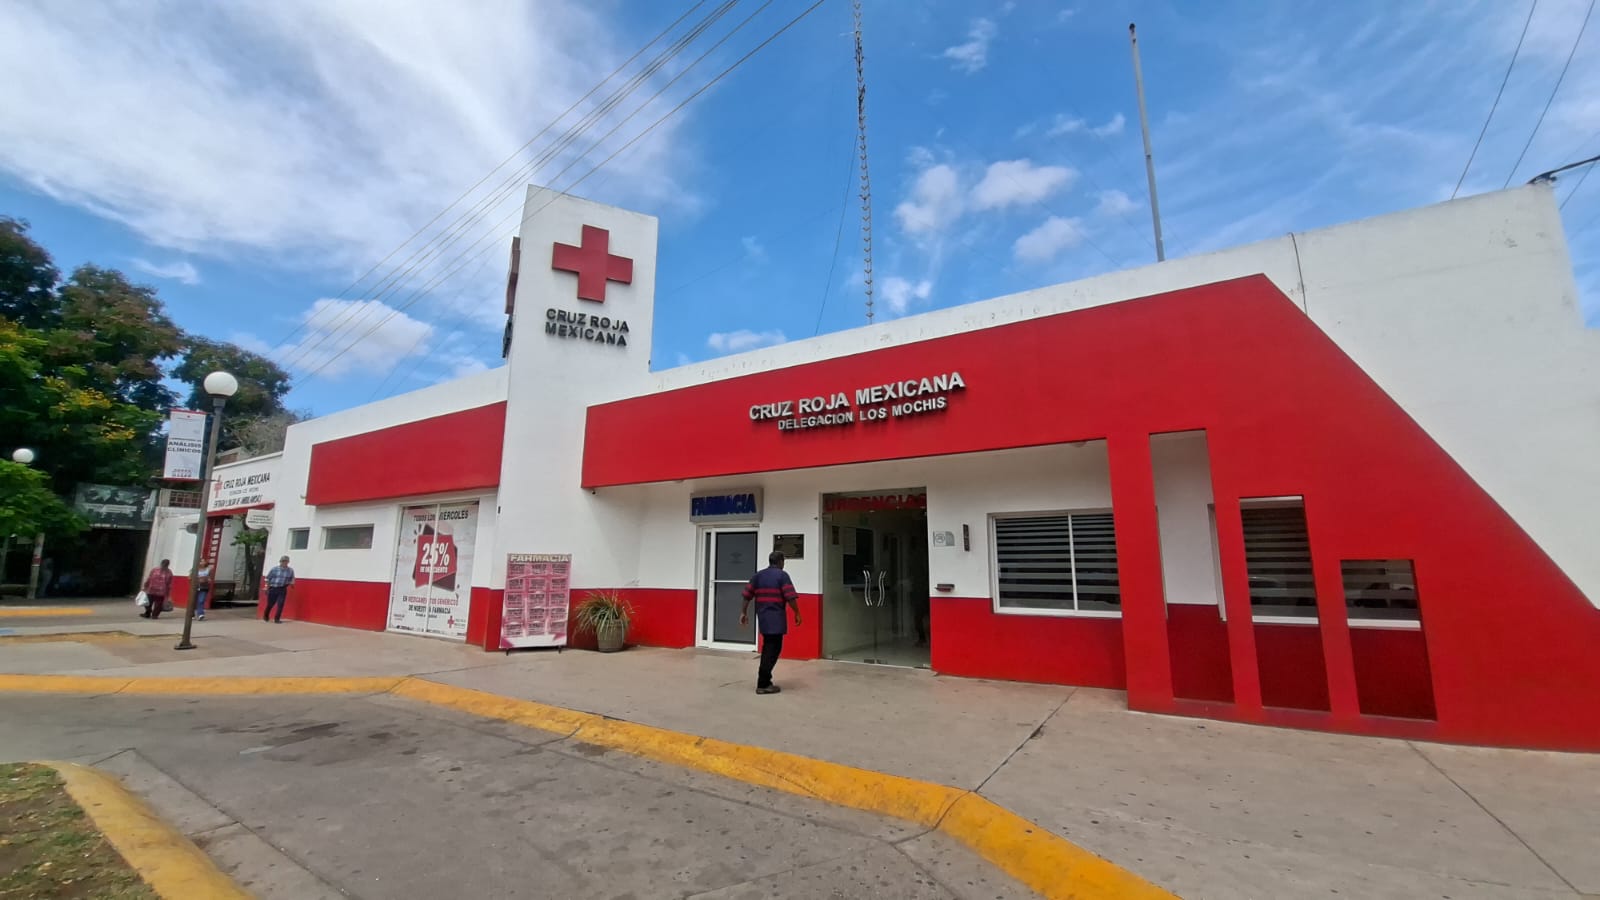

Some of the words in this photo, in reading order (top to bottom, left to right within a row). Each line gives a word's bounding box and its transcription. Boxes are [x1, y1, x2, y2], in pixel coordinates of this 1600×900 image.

[546, 308, 587, 325] CRUZ
[590, 315, 629, 333] ROJA
[545, 322, 627, 346] MEXICANA
[749, 401, 793, 420] CRUZ
[799, 392, 849, 414] ROJA
[855, 371, 965, 406] MEXICANA
[778, 411, 853, 430] DELEGACION
[859, 407, 887, 421] LOS
[892, 396, 947, 417] MOCHIS
[223, 479, 235, 489] CRUZ
[235, 477, 247, 487] ROJA
[247, 472, 271, 485] MEXICANA
[692, 493, 757, 517] FARMACIA
[421, 542, 450, 566] 25%
[510, 554, 569, 562] FARMACIA
[414, 605, 431, 613] NUESTA
